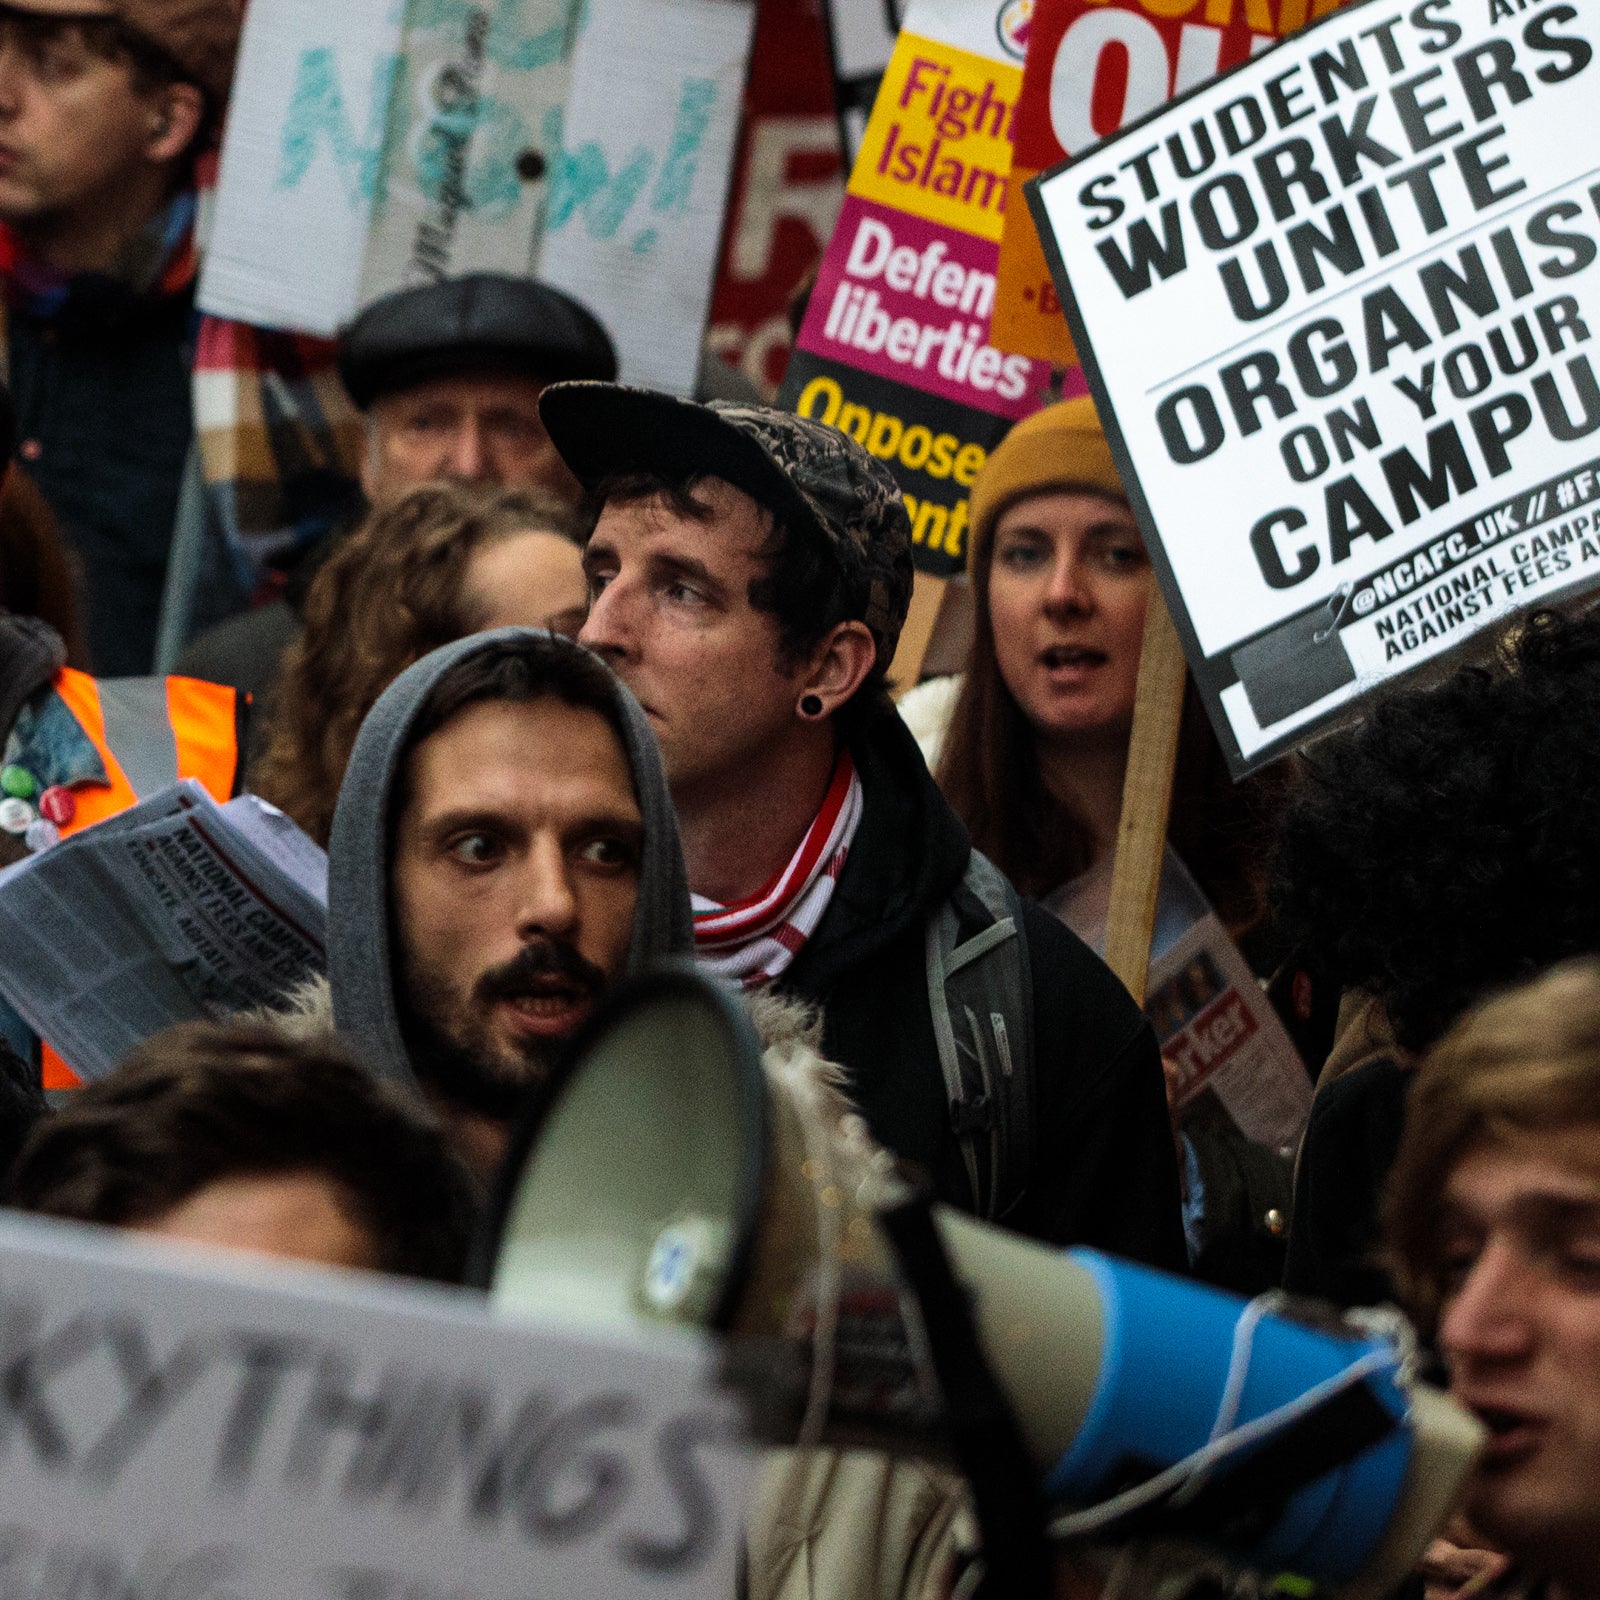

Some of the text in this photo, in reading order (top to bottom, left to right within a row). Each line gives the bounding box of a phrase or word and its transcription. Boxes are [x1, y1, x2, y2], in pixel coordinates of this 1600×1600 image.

[875, 122, 1010, 216] Islam
[1094, 4, 1593, 300] WORKERS
[845, 215, 998, 320] Defen
[1217, 123, 1527, 323] UNITE
[824, 279, 1033, 401] liberties
[1154, 186, 1600, 466] ORGANIS
[1279, 293, 1591, 483] ON YOUR
[1248, 353, 1600, 590] CAMPU
[1351, 504, 1521, 616] @NCAFC_UK
[1373, 556, 1507, 641] NATIONAL
[1383, 550, 1573, 663] AGAINST FEES
